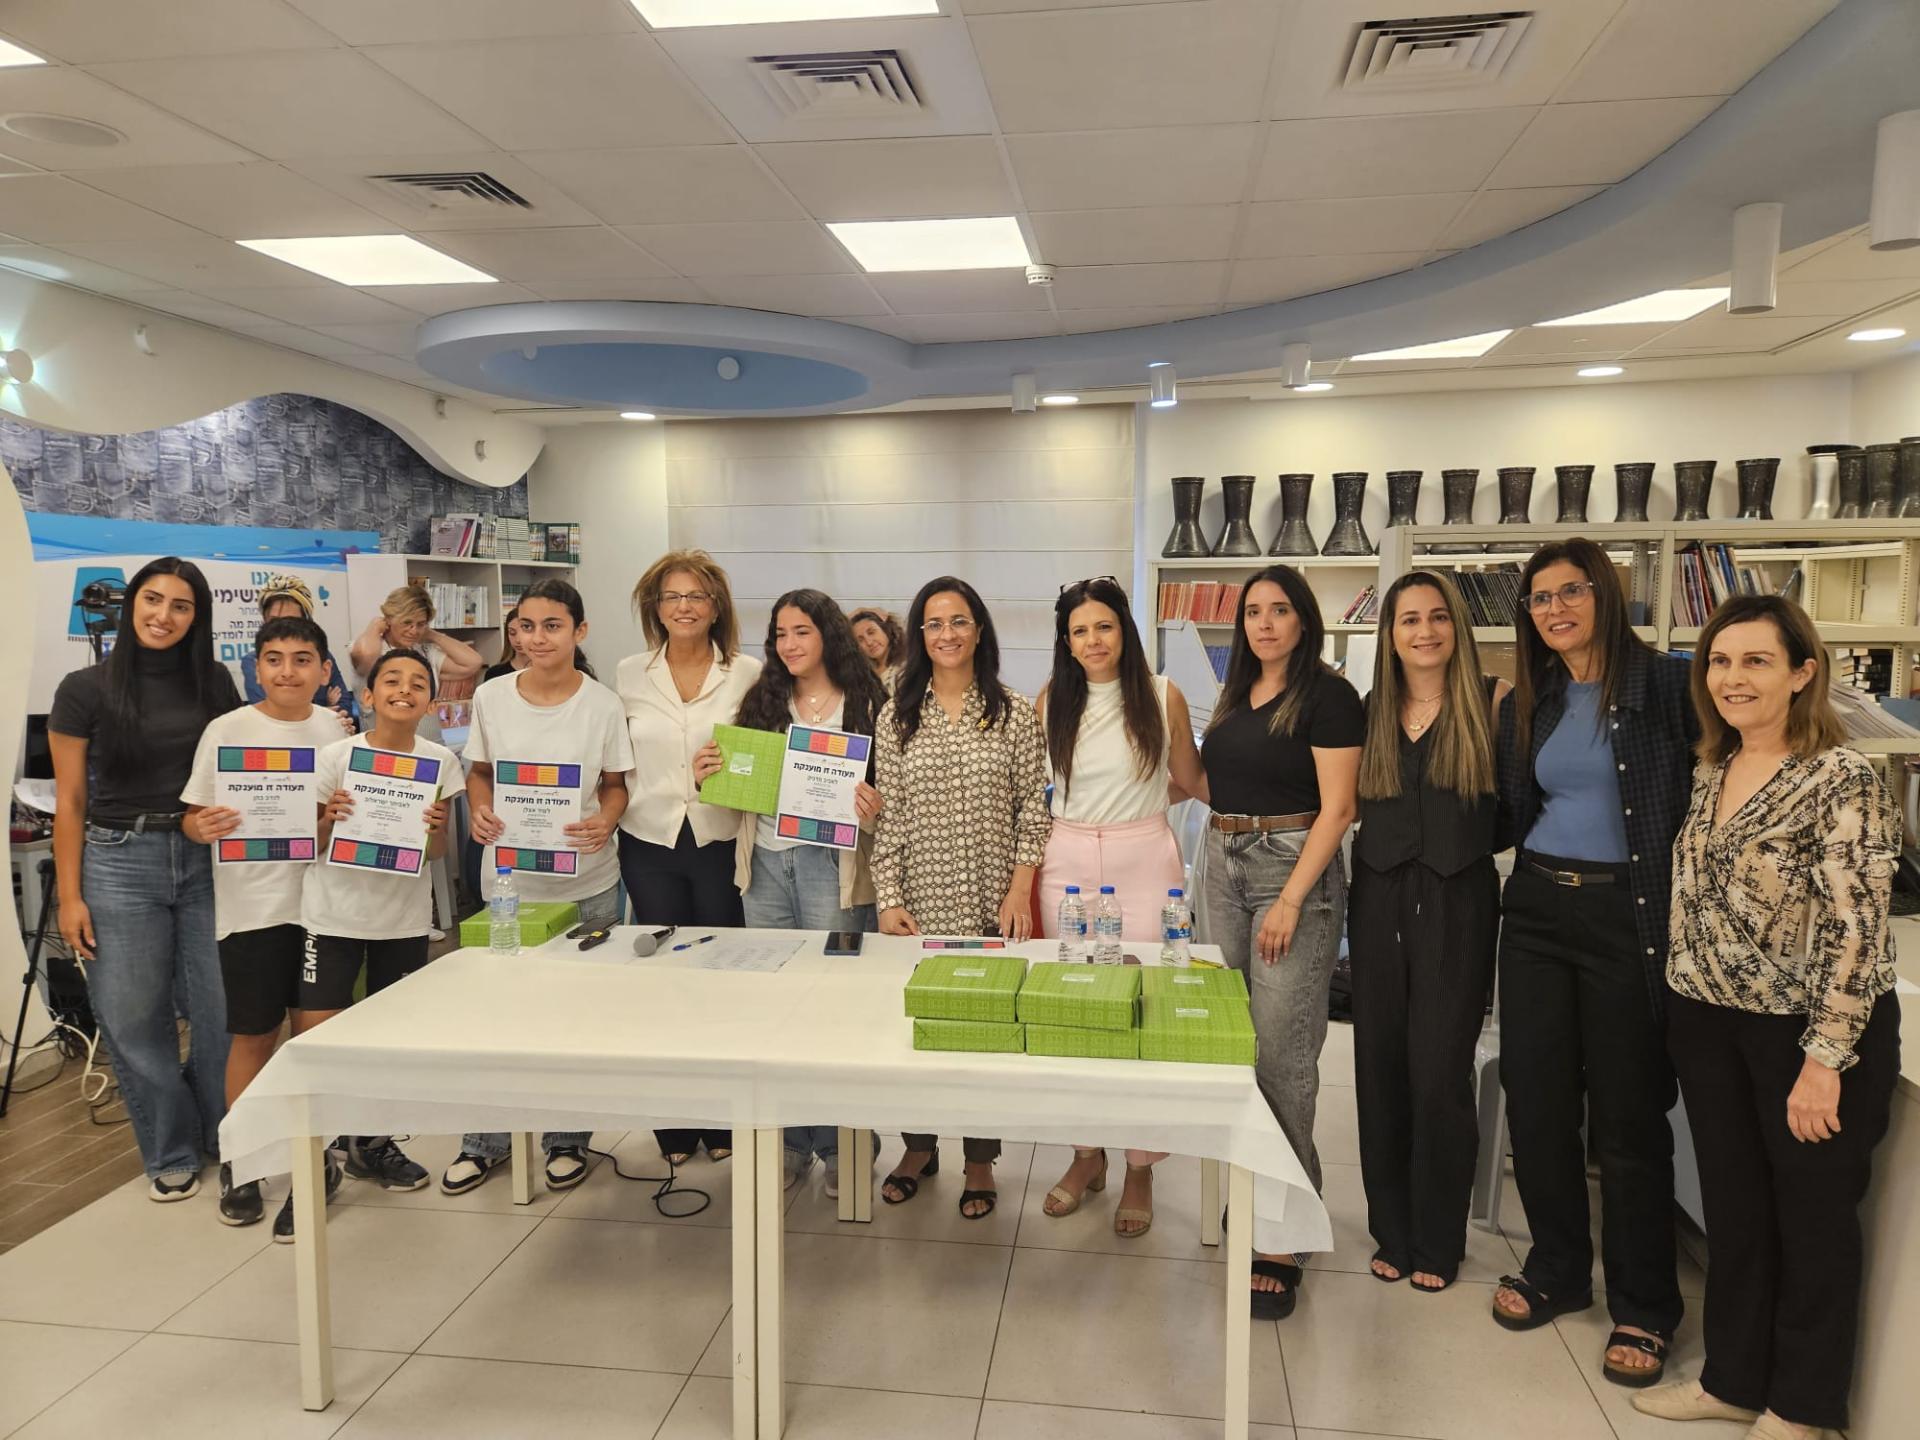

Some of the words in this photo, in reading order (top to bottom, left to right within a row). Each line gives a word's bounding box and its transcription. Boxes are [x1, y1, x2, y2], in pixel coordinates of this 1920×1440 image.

[793, 762, 822, 773] מוענקת
[831, 769, 855, 778] תעודה
[227, 784, 263, 792] מוענקת
[354, 784, 386, 796] מוענקת
[397, 791, 424, 801] תעודה
[504, 795, 535, 804] מוענקת
[545, 798, 570, 806] תעודה
